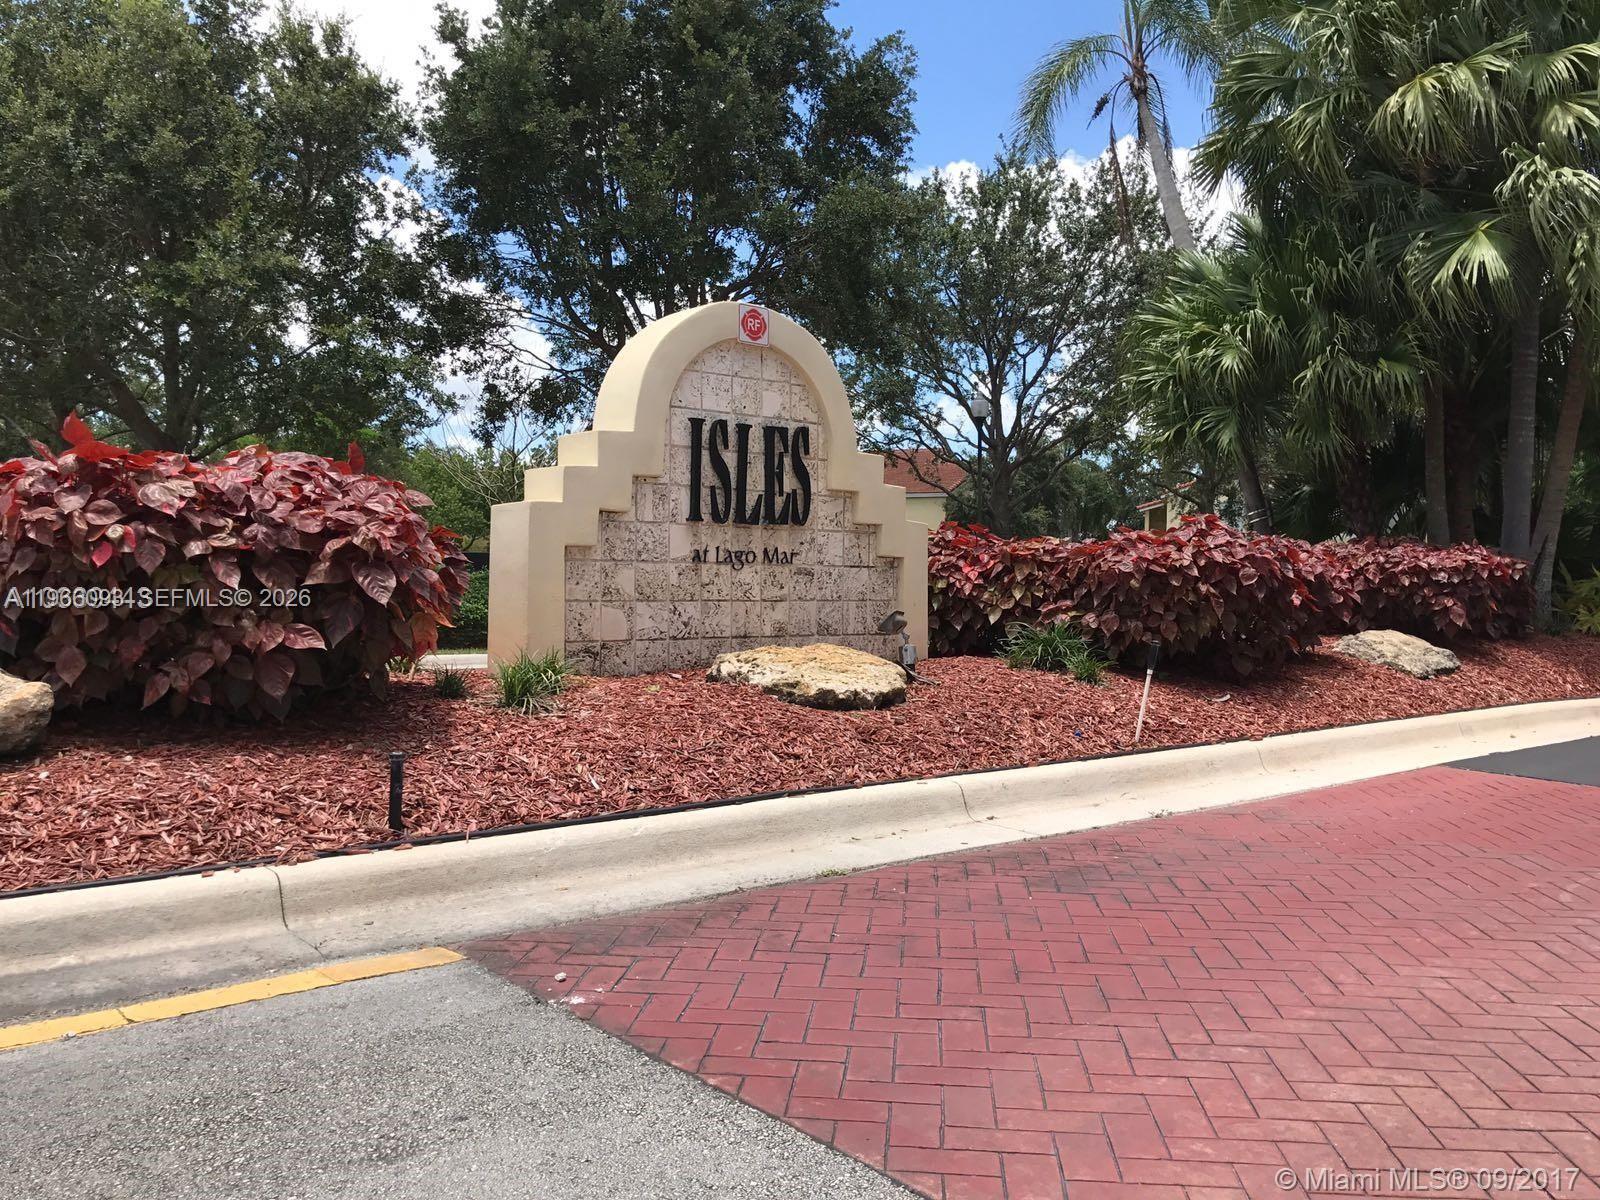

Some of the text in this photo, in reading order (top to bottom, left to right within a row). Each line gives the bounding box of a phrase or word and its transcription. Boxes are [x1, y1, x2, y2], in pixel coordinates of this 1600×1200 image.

[747, 318, 761, 332] RF
[686, 417, 812, 526] ISLES
[691, 545, 799, 570] at Lago Mar
